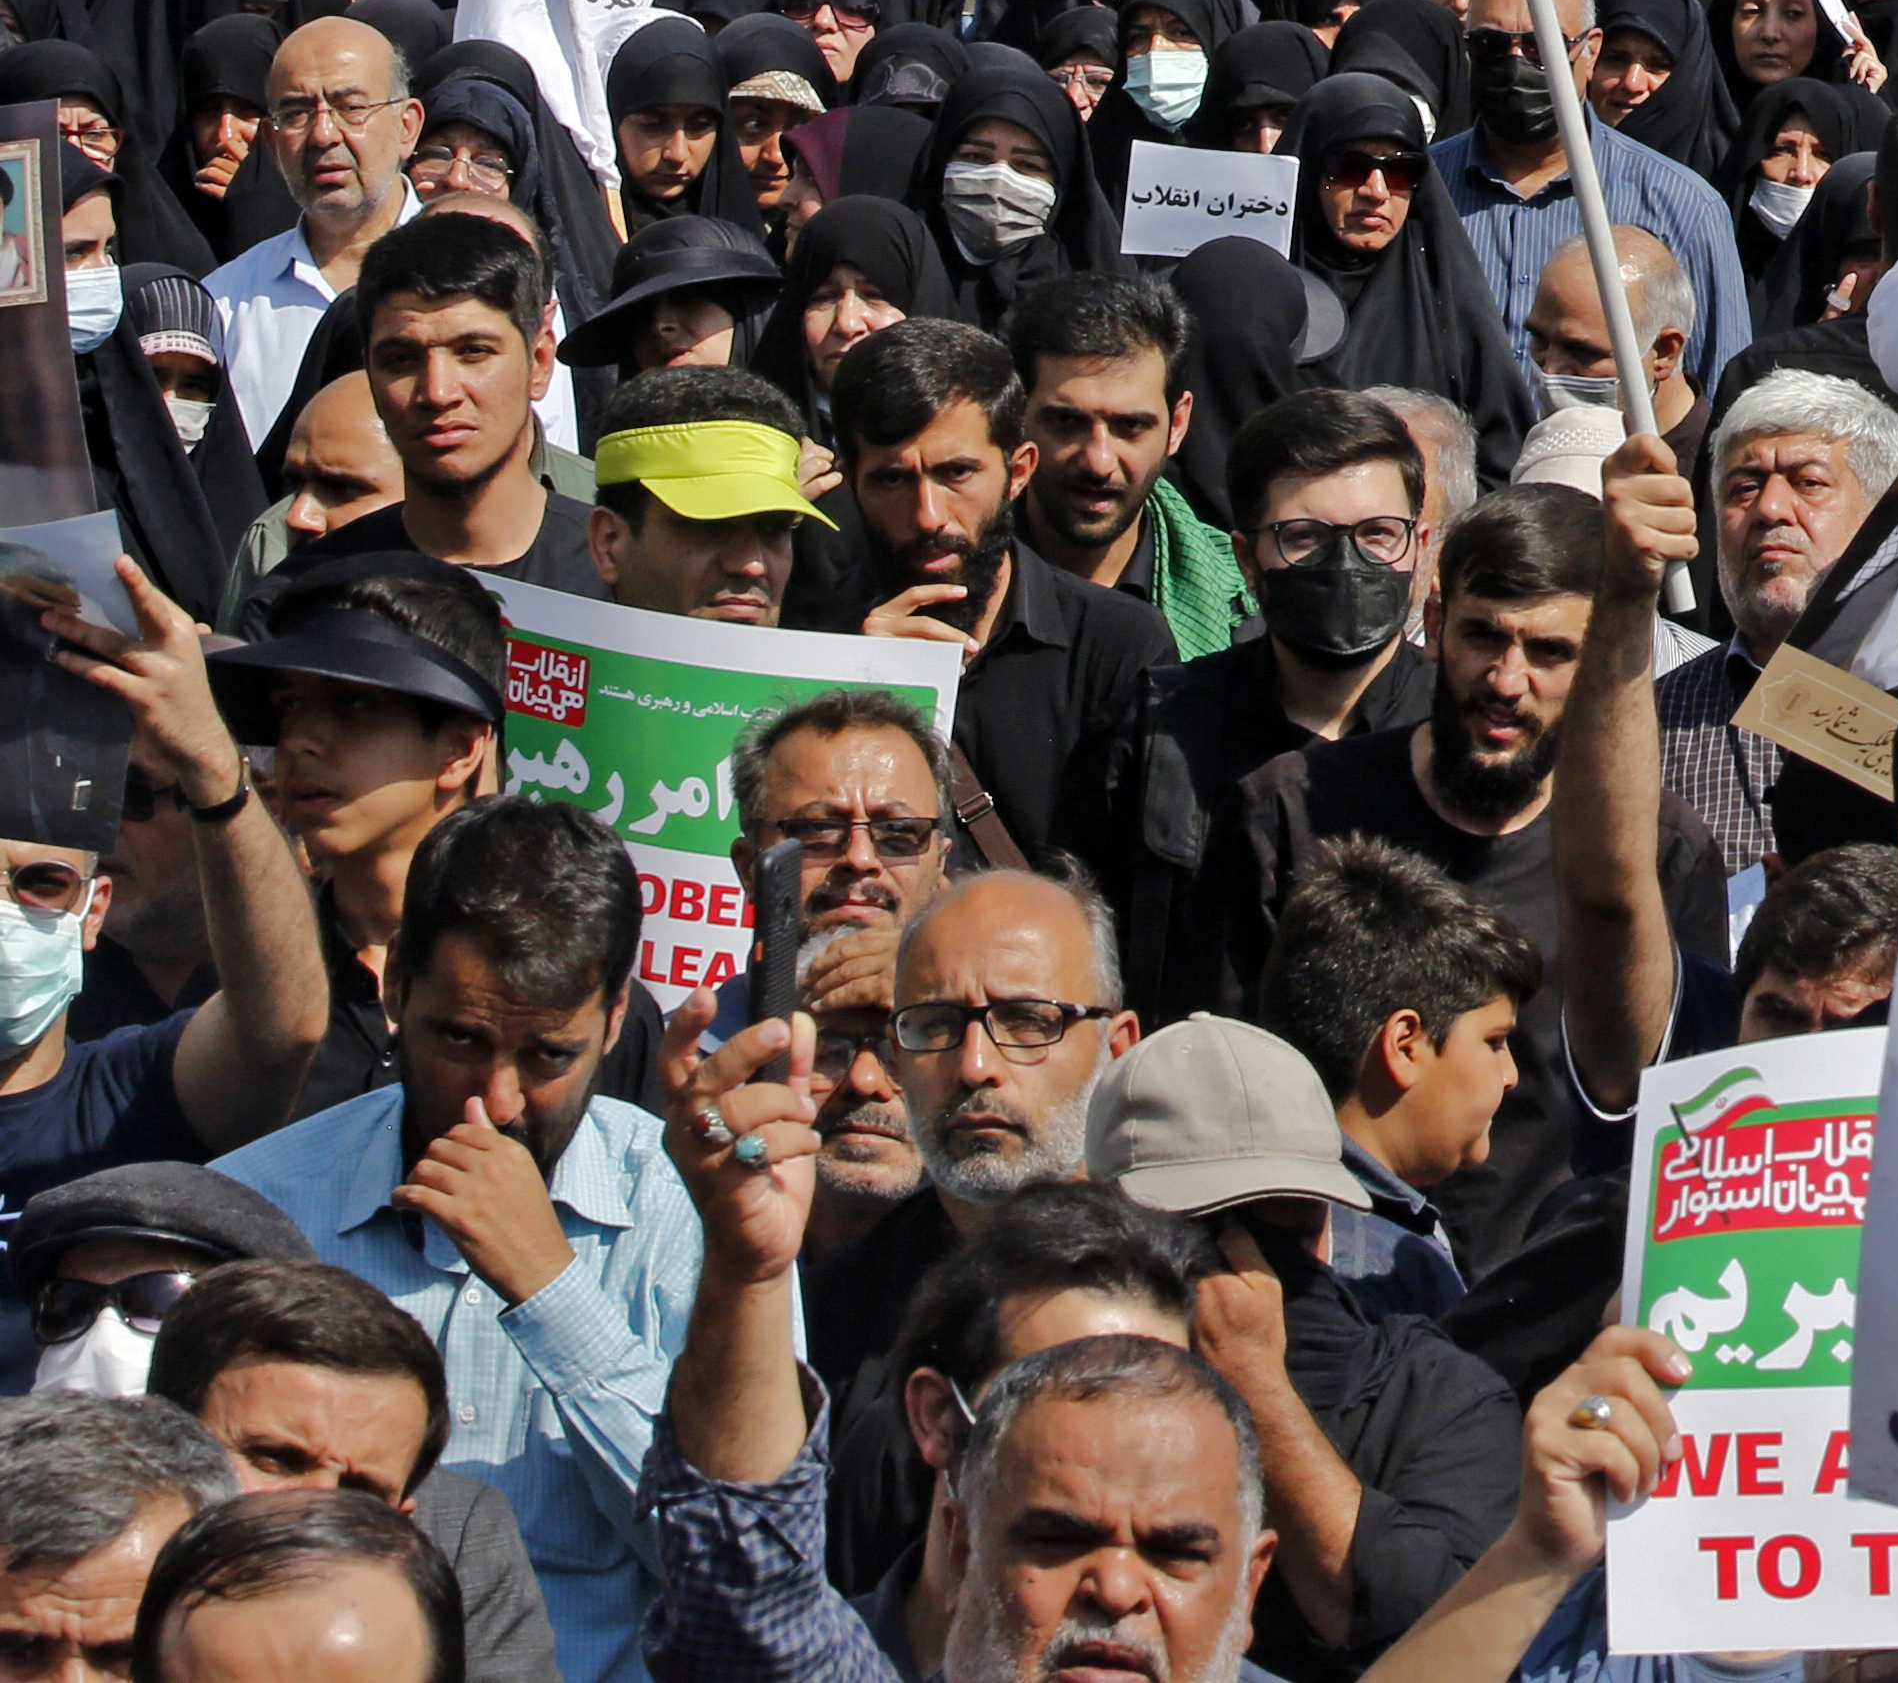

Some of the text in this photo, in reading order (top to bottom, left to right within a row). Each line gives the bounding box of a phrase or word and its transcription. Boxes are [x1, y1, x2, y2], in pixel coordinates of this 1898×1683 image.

[1131, 184, 1289, 219] دختران انقلاب
[510, 652, 586, 690] انقلاب
[598, 683, 635, 700] هستند
[637, 691, 681, 707] رهبری
[692, 701, 738, 718] اسلامی
[1659, 1169, 1770, 1236] استوار
[1653, 1433, 1782, 1498] WE
[1698, 1535, 1822, 1600] TO
